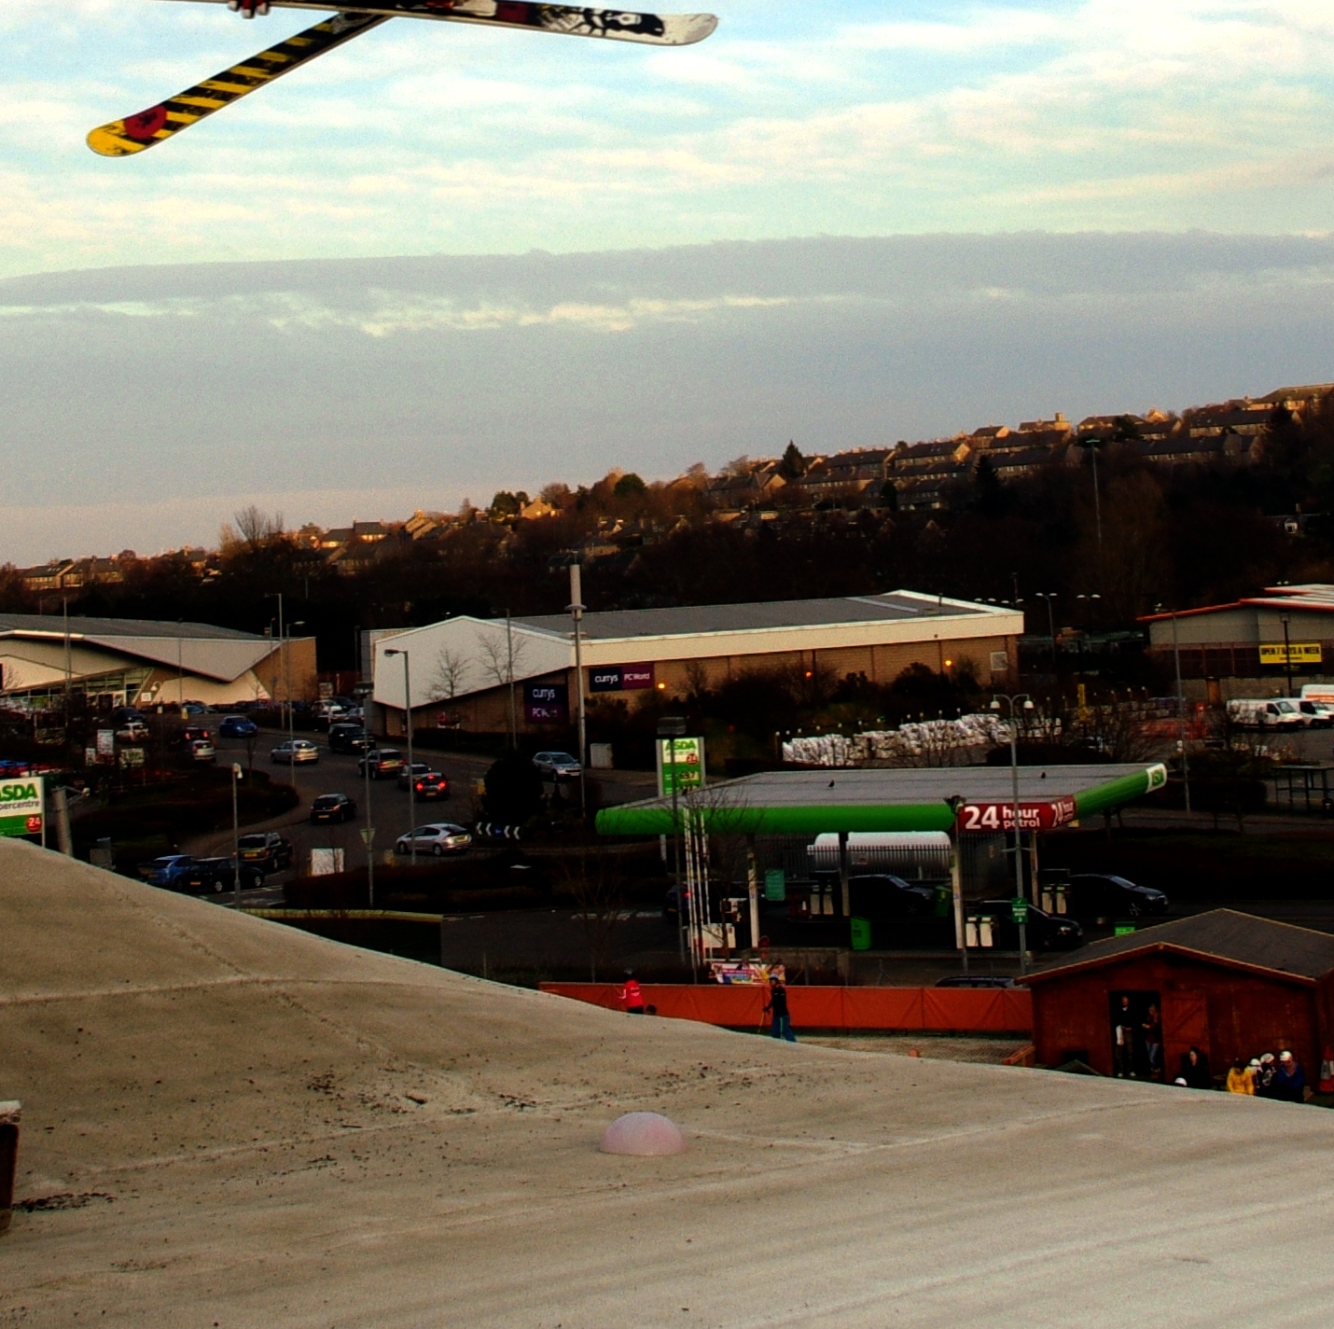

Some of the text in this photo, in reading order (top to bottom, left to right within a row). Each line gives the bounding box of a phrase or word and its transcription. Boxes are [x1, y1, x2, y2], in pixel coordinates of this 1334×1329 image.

[594, 673, 619, 685] currys
[532, 688, 556, 701] currys
[964, 805, 1040, 830] 24 hour
[1003, 817, 1041, 830] petrol
